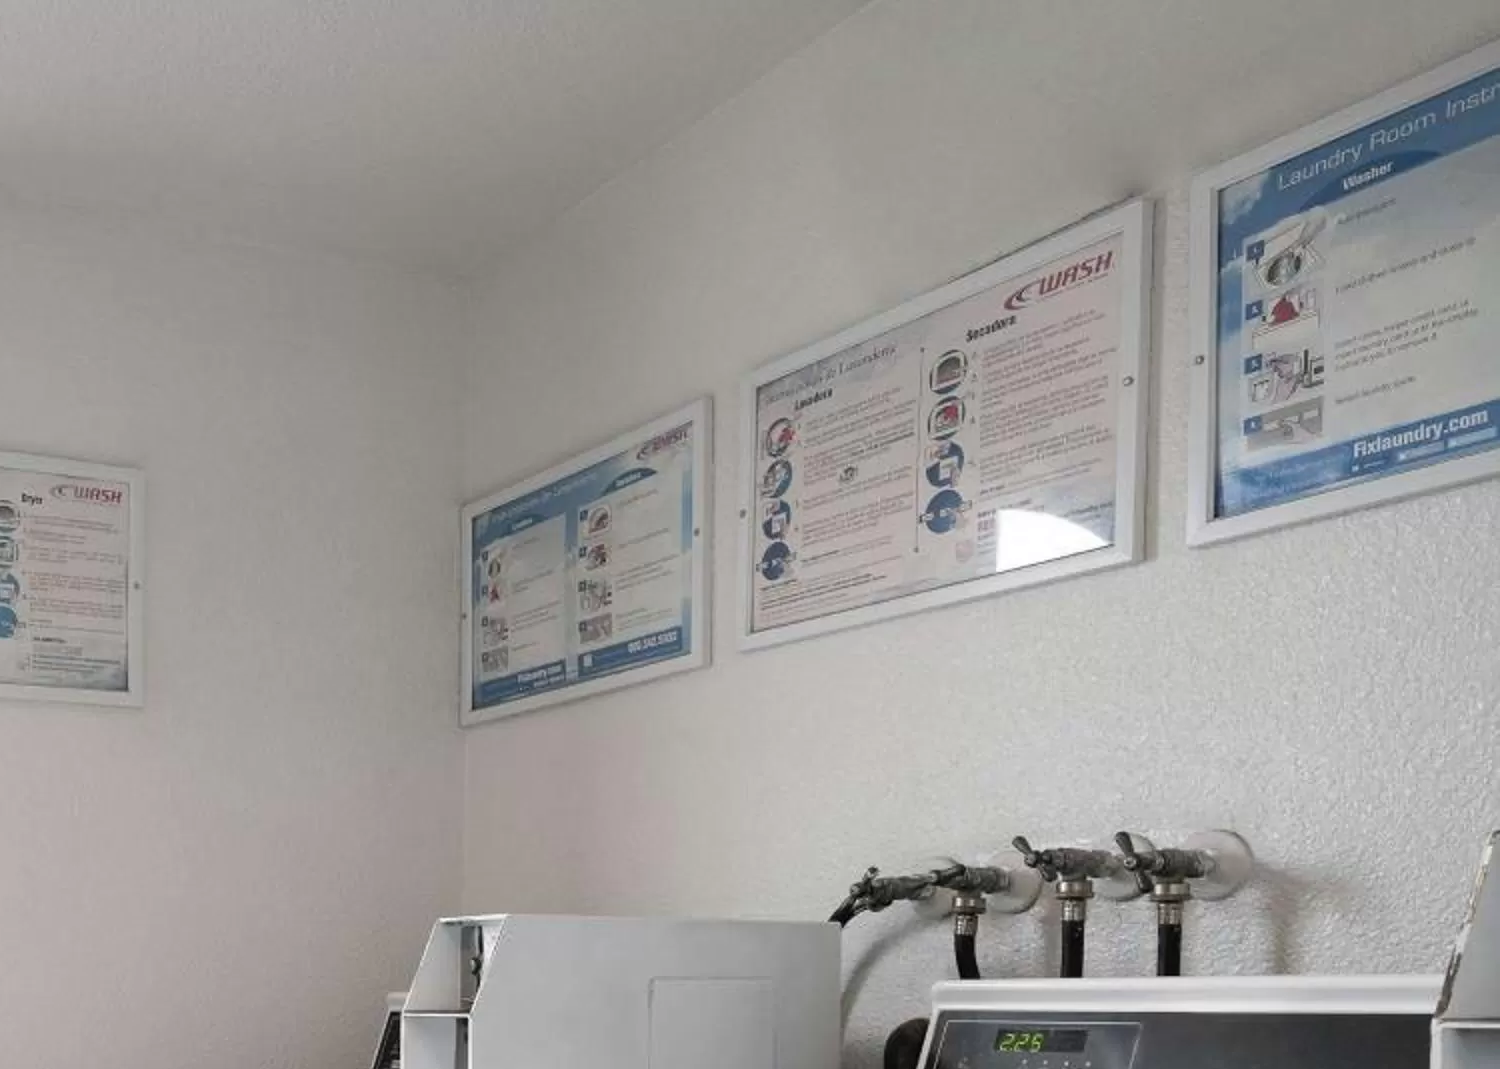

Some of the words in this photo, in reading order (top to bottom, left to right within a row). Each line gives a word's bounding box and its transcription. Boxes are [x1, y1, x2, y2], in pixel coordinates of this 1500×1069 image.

[1278, 142, 1363, 190] Laundry
[1370, 111, 1436, 151] Room
[1039, 251, 1112, 296] WASH
[74, 485, 122, 504] WASH
